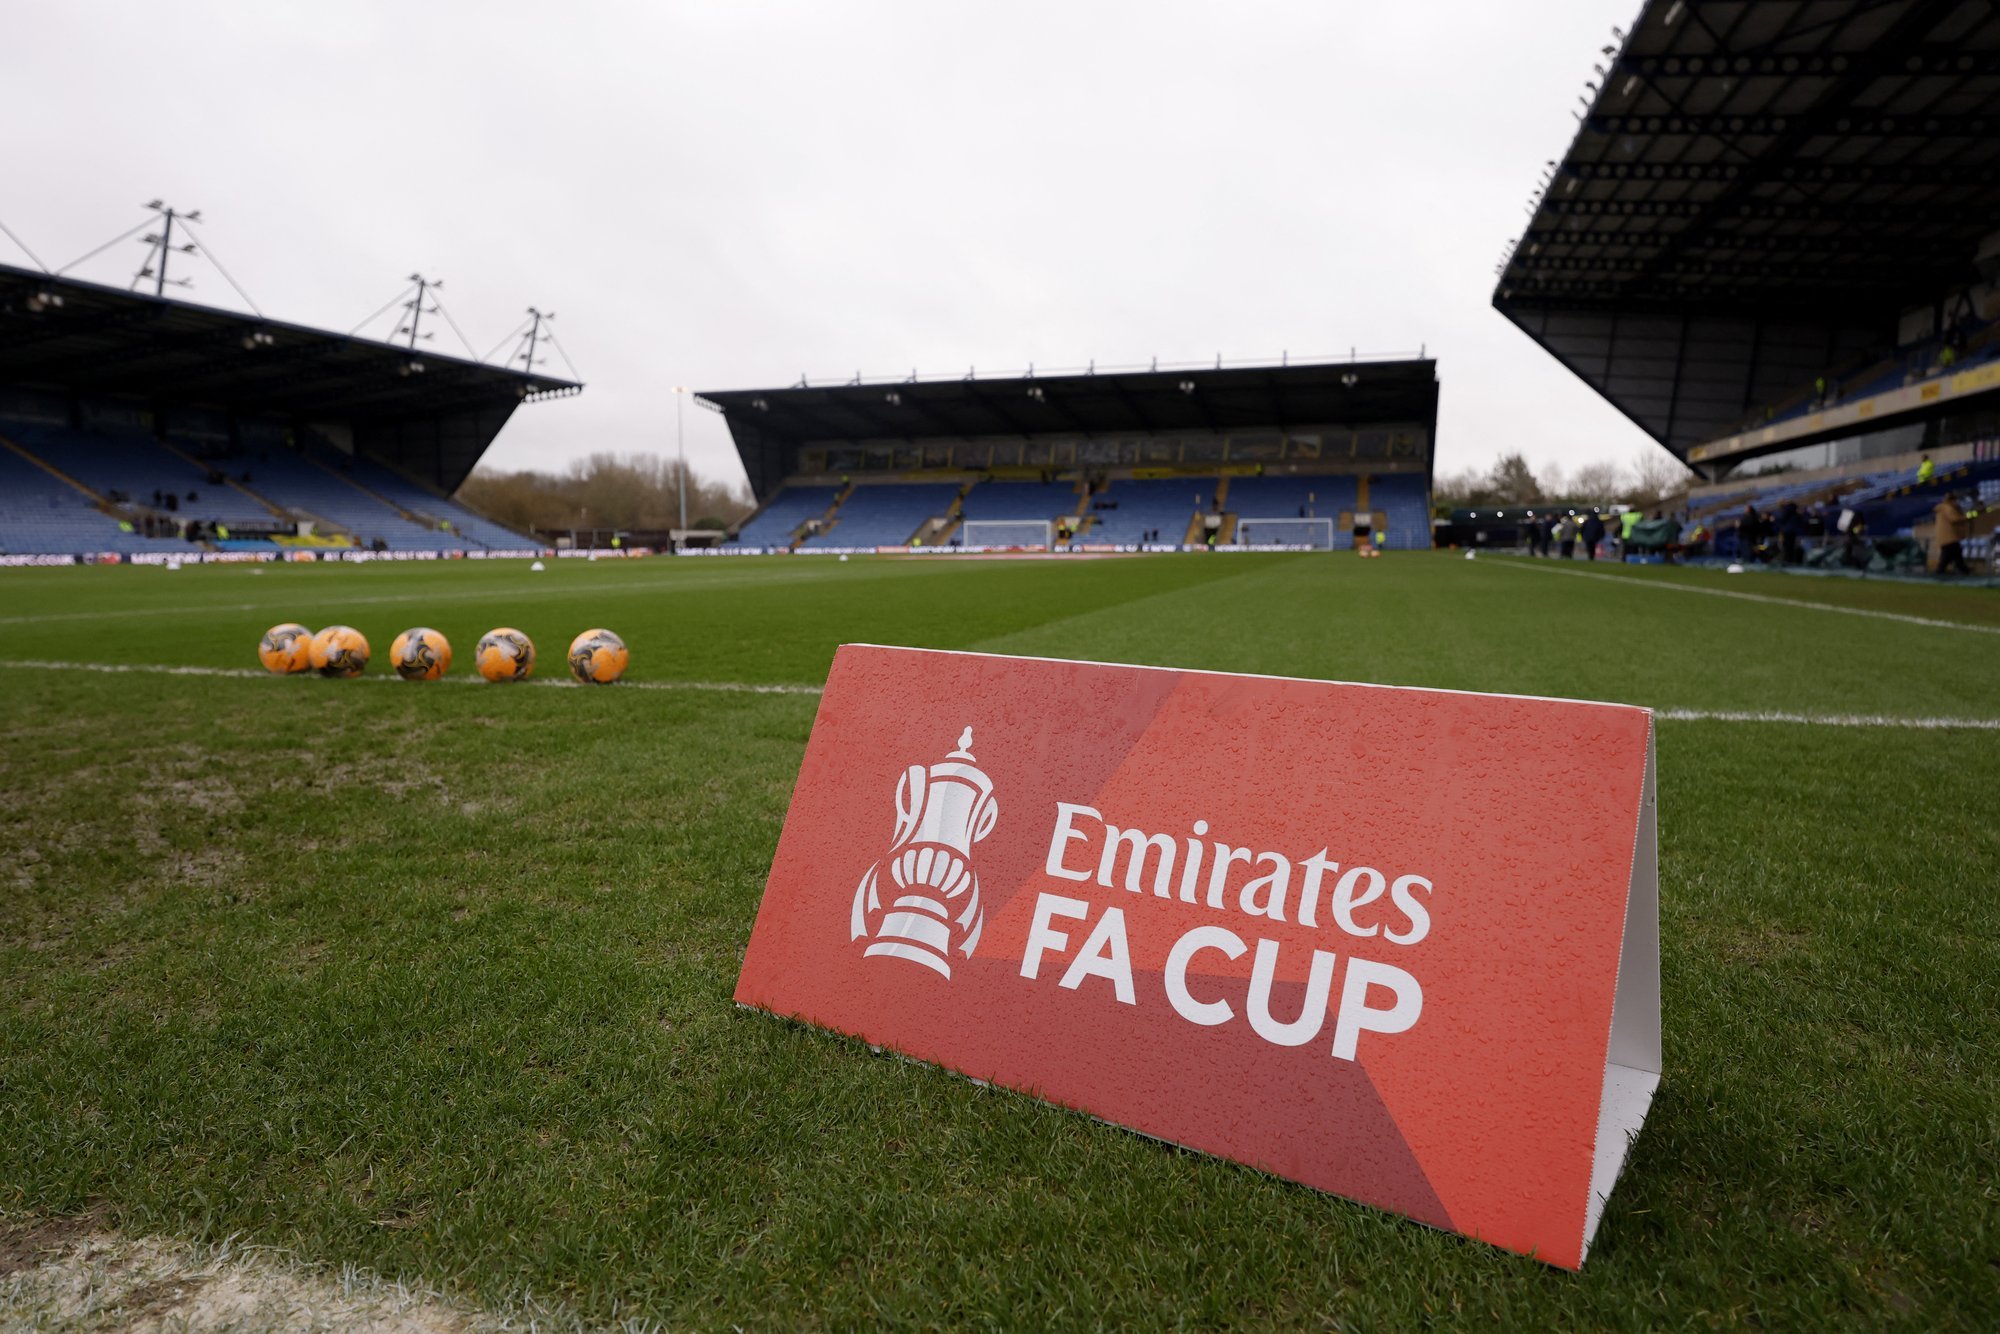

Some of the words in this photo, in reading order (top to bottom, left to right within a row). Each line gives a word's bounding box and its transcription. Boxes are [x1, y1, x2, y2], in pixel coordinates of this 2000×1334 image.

[1046, 802, 1432, 945] Emirates
[1020, 892, 1136, 1006] FA
[1165, 926, 1423, 1061] CUP
